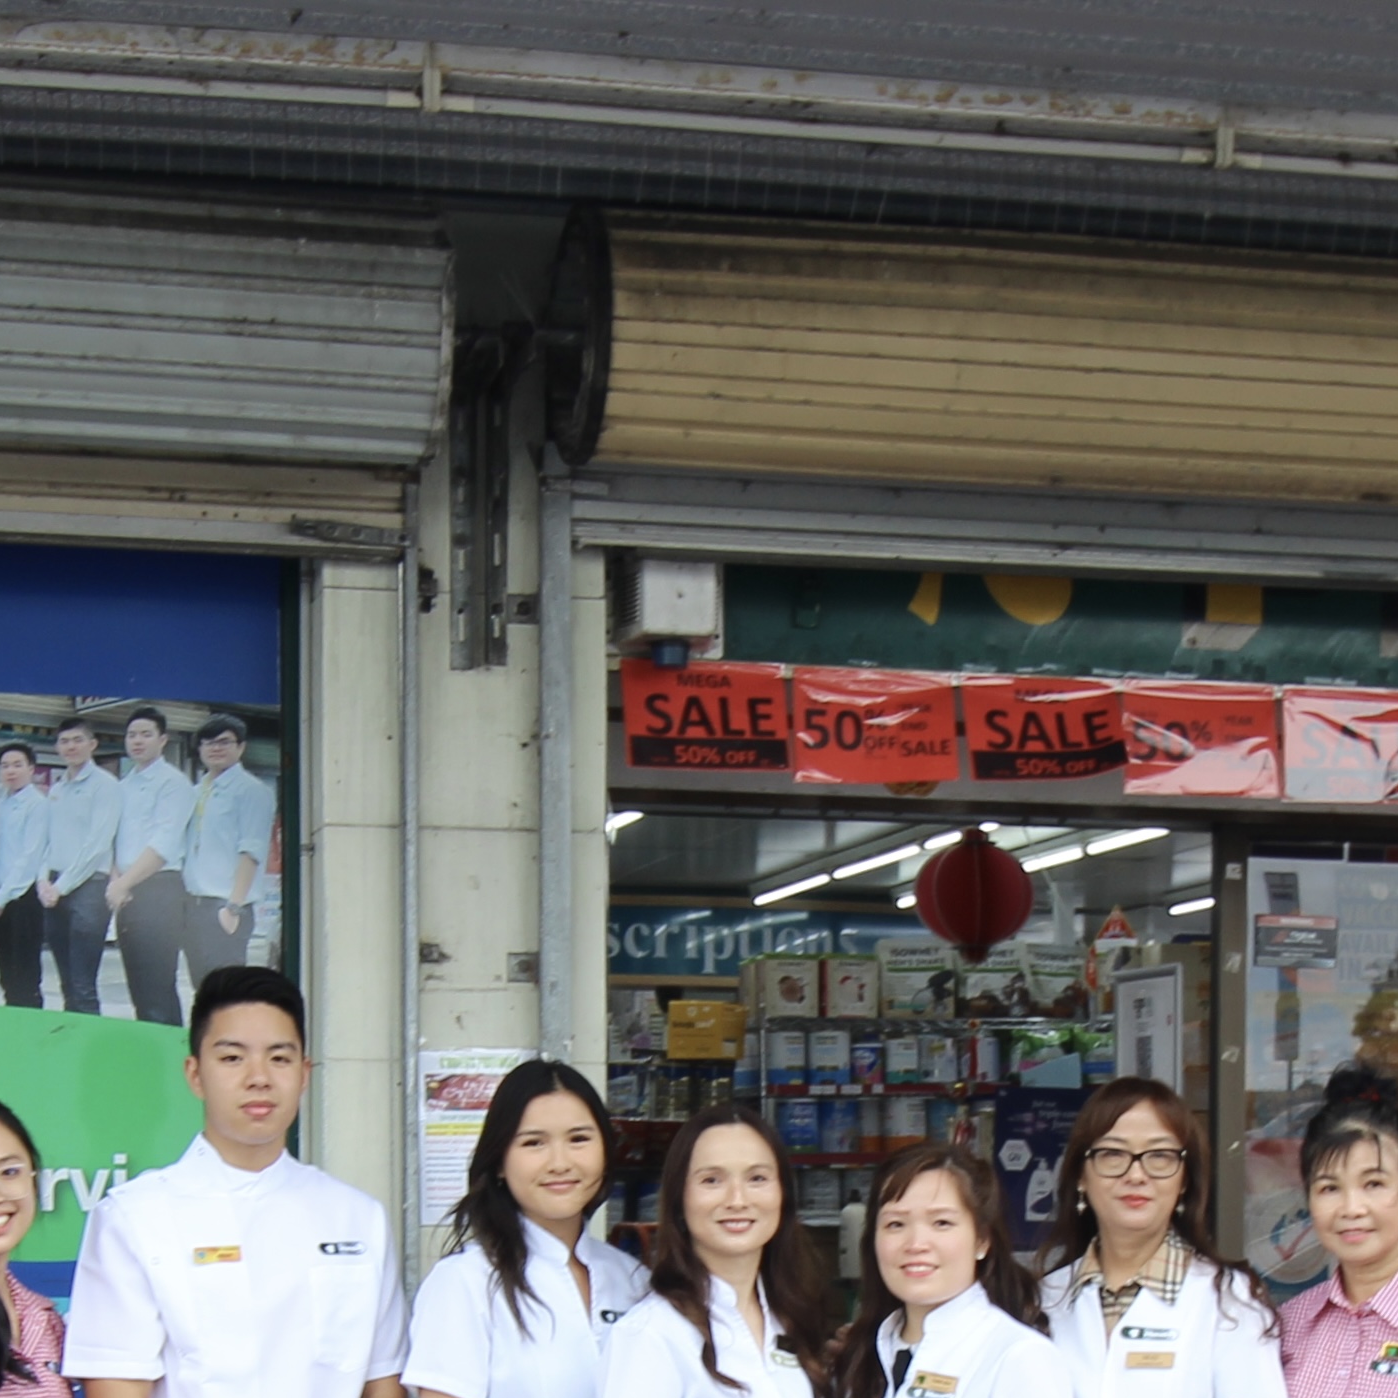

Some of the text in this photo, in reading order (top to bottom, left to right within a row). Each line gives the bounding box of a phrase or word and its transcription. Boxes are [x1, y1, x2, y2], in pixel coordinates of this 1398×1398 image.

[644, 693, 776, 738] SALE
[984, 708, 1114, 751] SALE
[674, 745, 757, 765] 50% OFF
[901, 739, 950, 757] SALE
[1015, 759, 1061, 776] 50%
